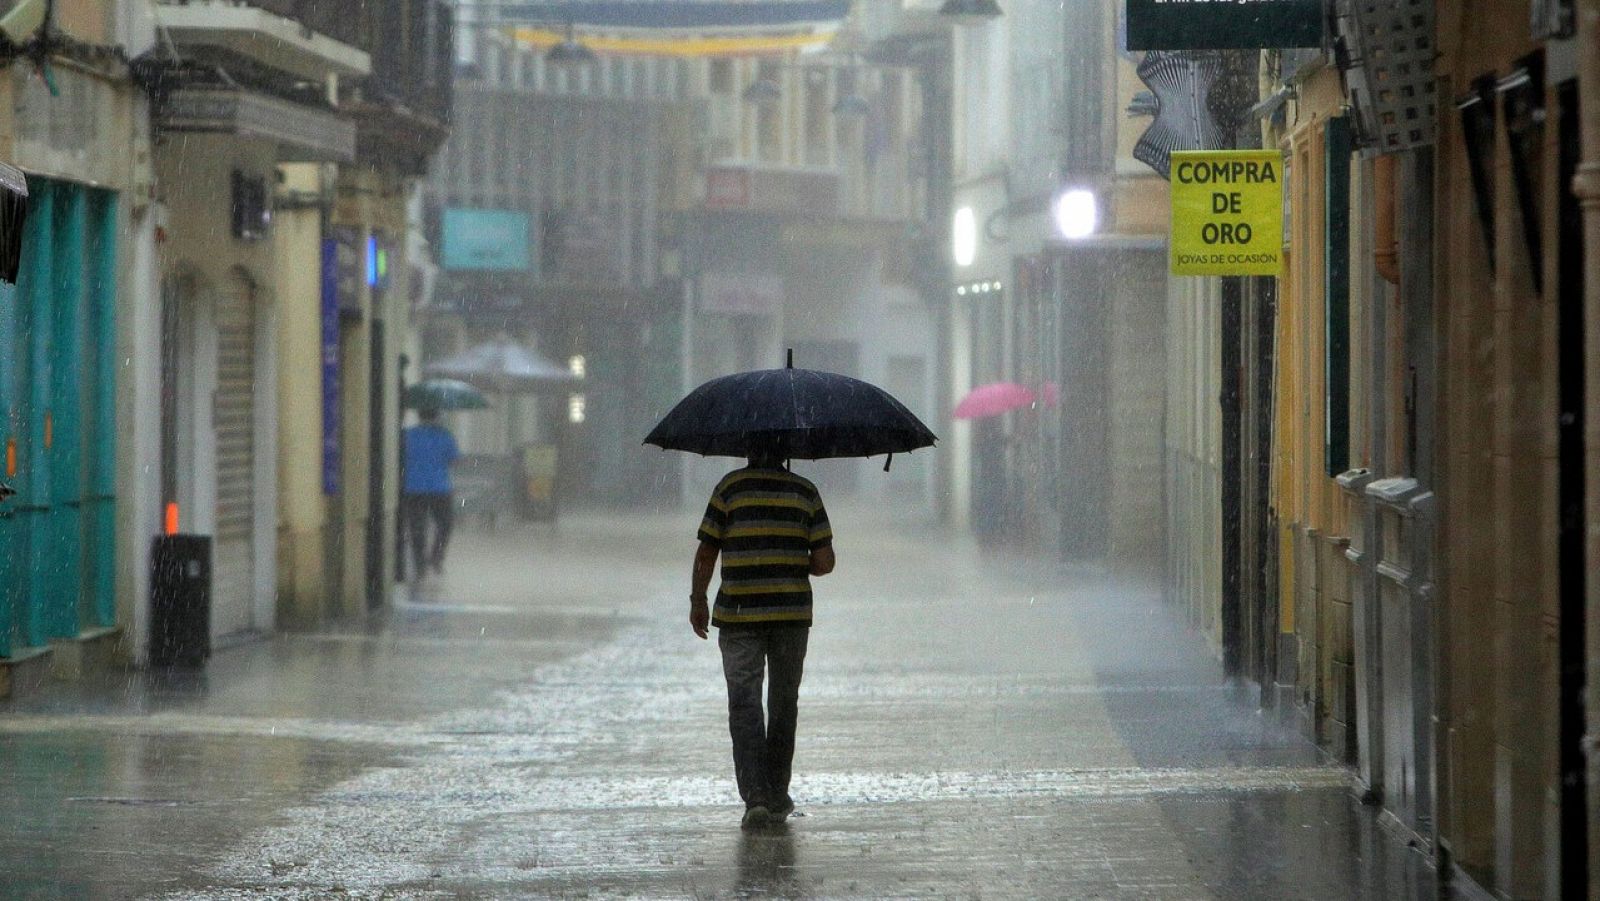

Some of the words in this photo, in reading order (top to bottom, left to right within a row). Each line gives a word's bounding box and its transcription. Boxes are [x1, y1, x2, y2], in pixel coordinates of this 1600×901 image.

[1177, 161, 1276, 184] COMPRA
[1212, 192, 1242, 214] DE
[1201, 222, 1252, 245] ORO
[1177, 254, 1208, 265] JOYAS
[1210, 254, 1225, 264] DE
[1227, 252, 1277, 264] OCASIÓN
